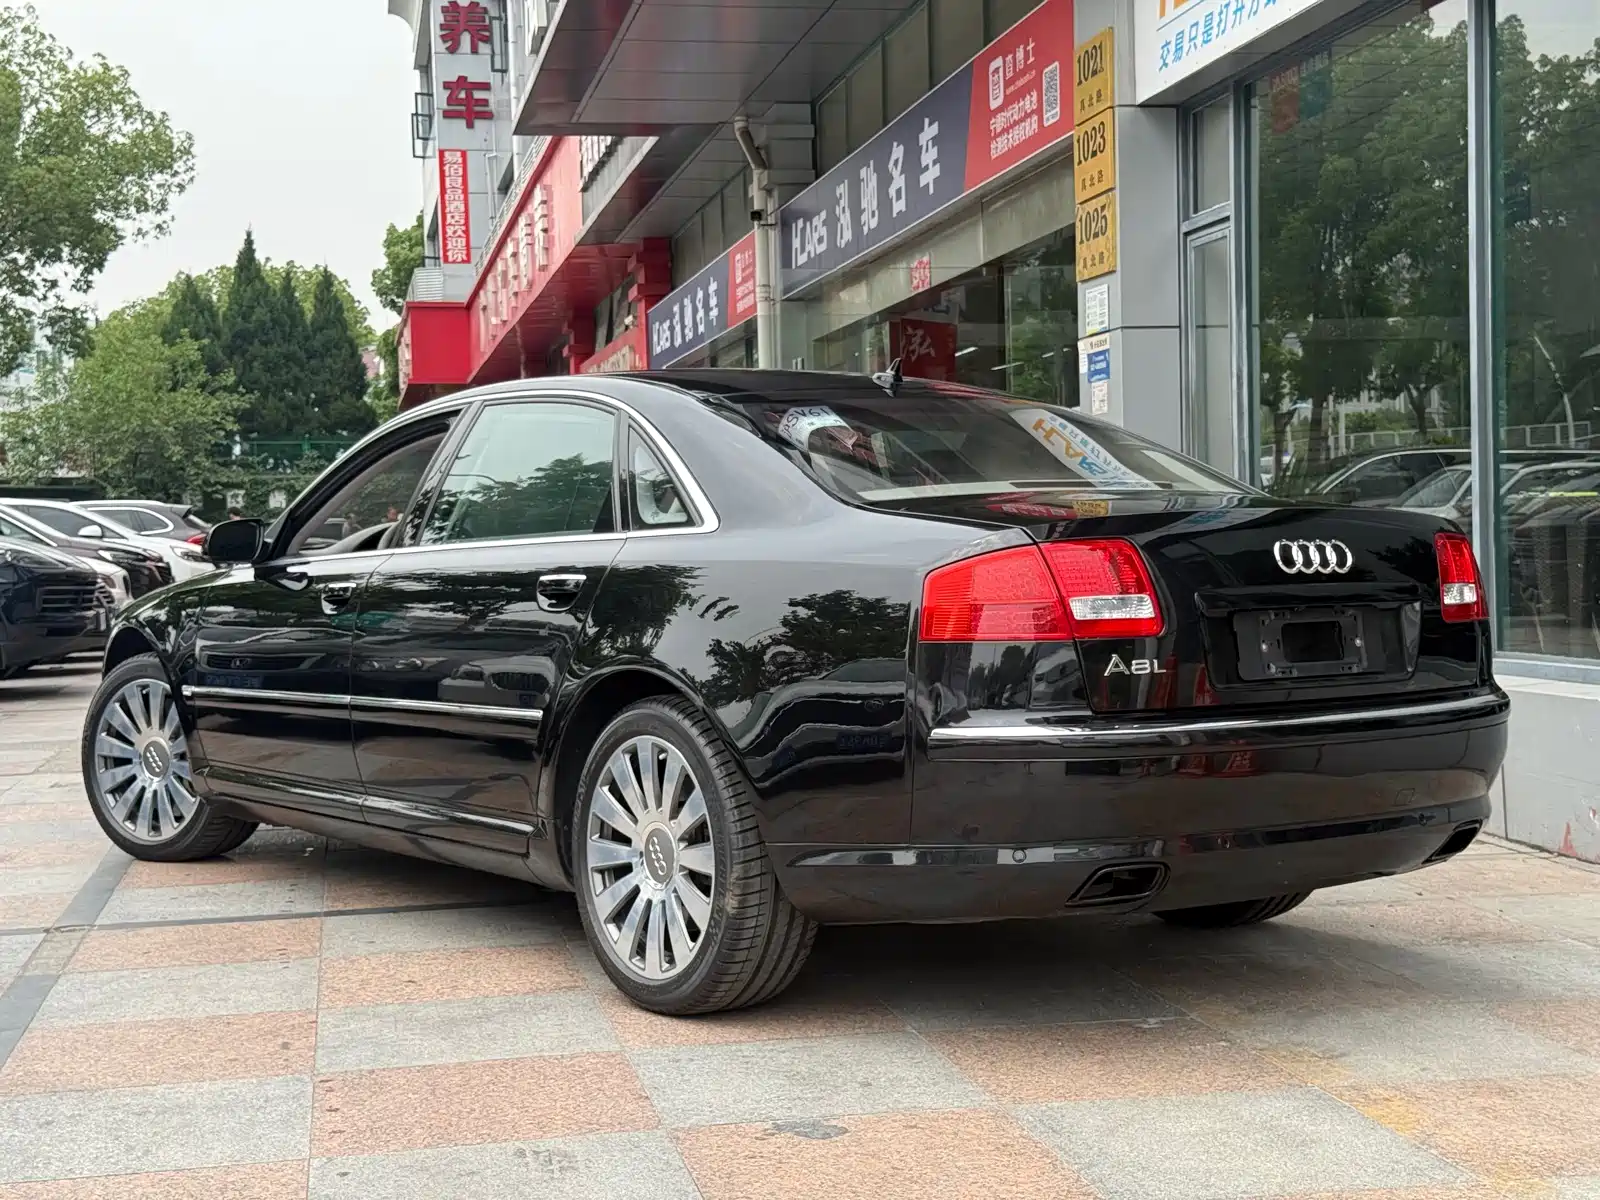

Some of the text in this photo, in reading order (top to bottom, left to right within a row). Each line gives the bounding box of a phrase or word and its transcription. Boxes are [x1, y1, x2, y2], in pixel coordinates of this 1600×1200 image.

[440, 1, 494, 129] 养车
[1005, 37, 1036, 80] 查博士
[1076, 40, 1105, 87] 1021
[1076, 120, 1106, 166] 1023
[835, 117, 941, 249] 泓驰名车
[1080, 169, 1104, 193] 真北路
[442, 151, 468, 262] 易佰良品酒店欢迎你
[1078, 203, 1109, 245] 1025
[1081, 251, 1105, 270] 真北路
[1103, 653, 1166, 678] A8L
